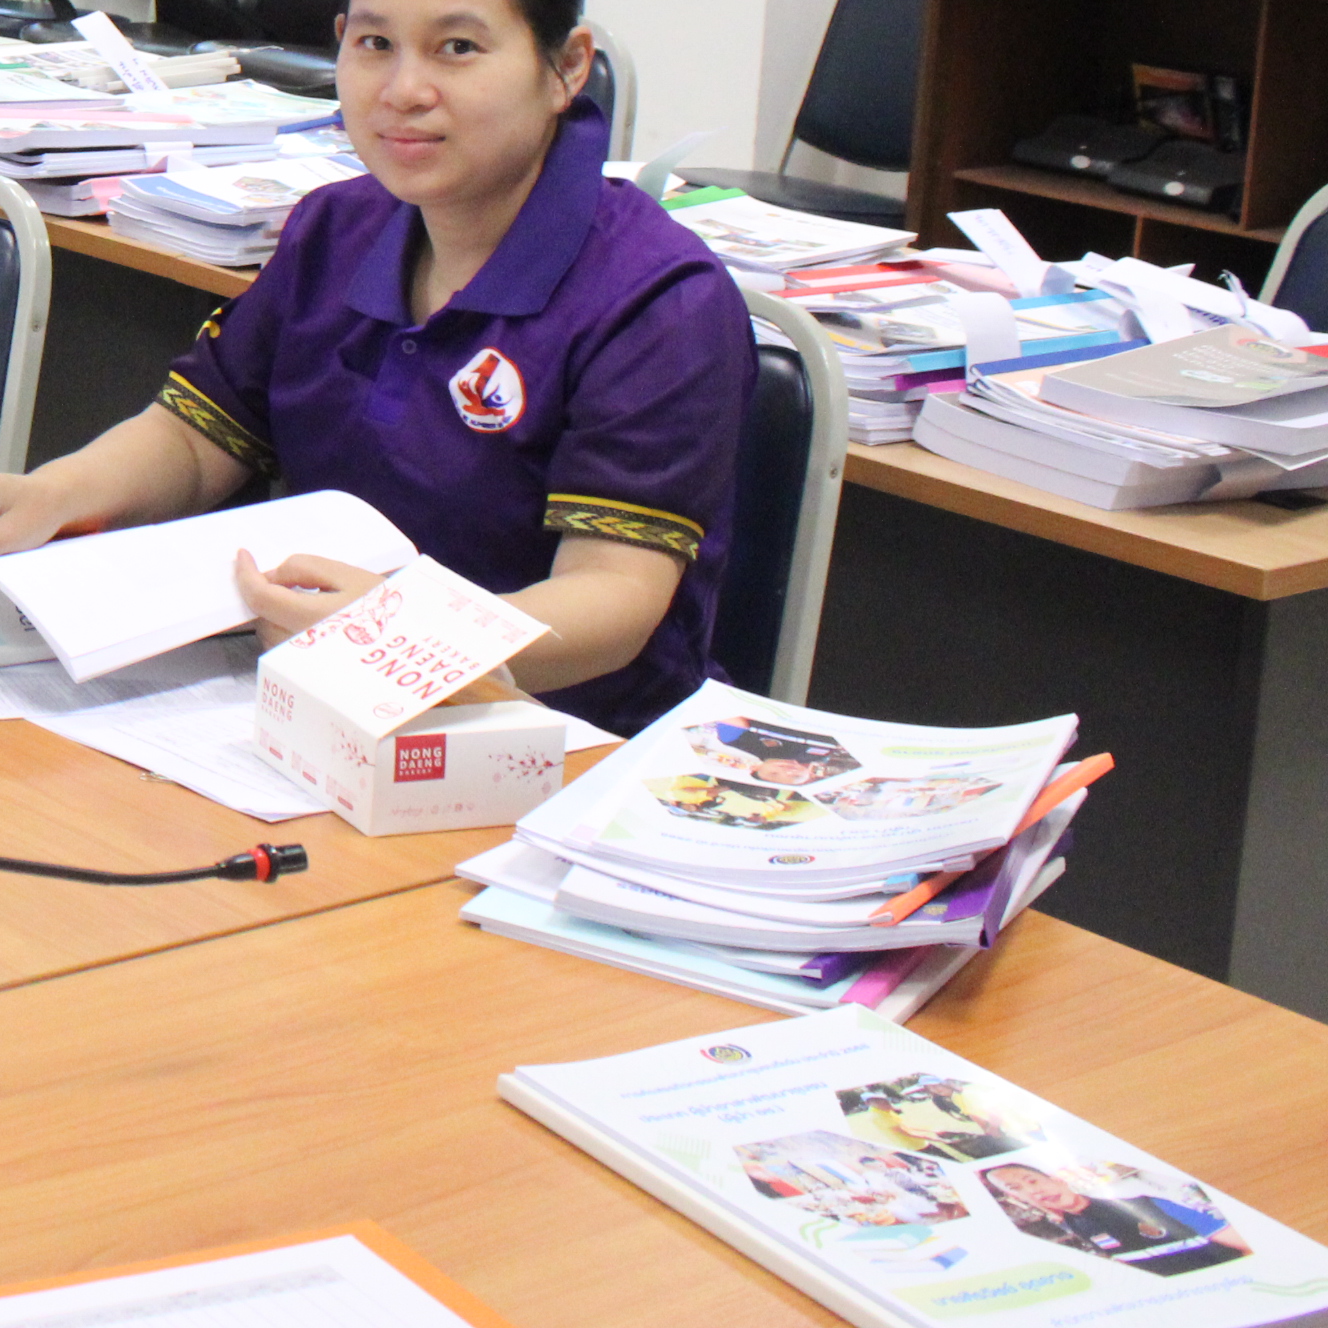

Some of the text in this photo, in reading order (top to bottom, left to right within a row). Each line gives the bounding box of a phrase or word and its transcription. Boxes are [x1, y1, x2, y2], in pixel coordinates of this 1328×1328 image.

[386, 635, 465, 684] DAENG
[422, 635, 481, 670] BAKERY
[360, 648, 443, 700] NONG
[262, 693, 293, 722] DAENG
[263, 676, 294, 708] NONG
[399, 746, 443, 760] NONG
[399, 757, 443, 770] DAENG
